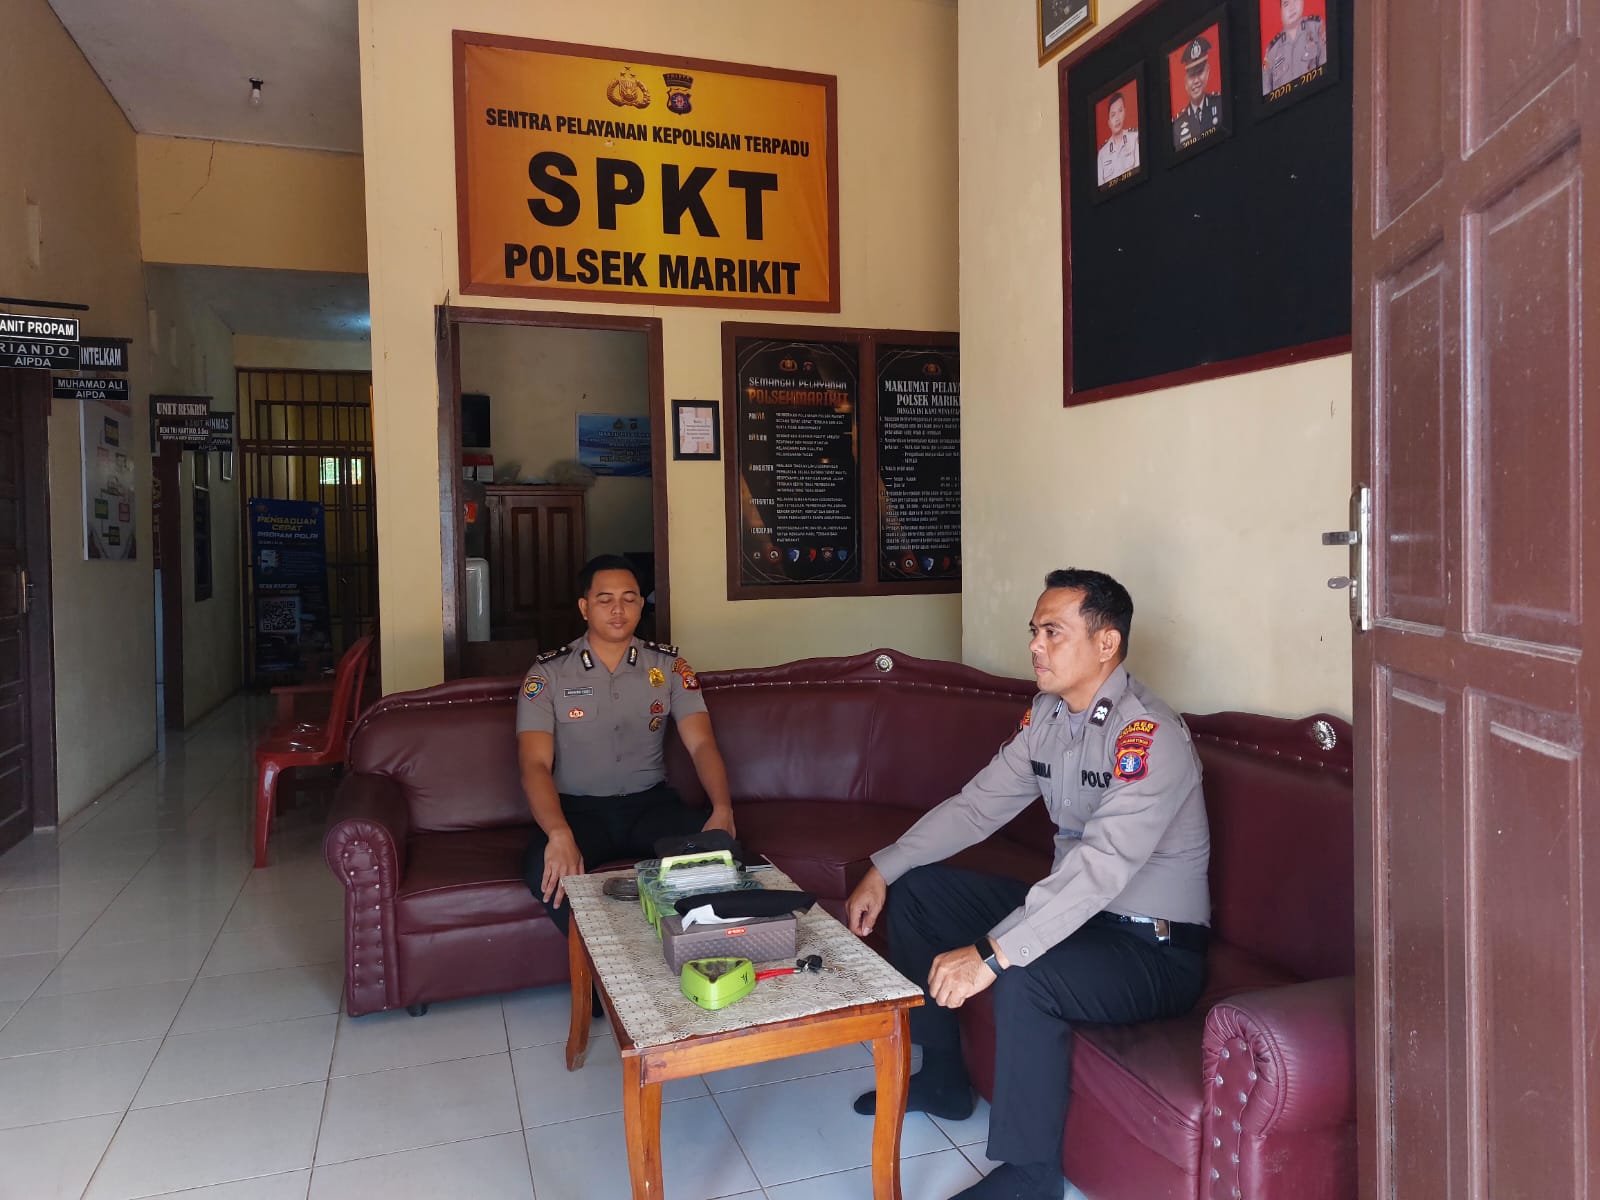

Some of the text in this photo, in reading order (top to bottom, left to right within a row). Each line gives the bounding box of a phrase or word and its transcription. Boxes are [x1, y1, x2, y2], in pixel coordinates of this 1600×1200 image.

[1300, 66, 1324, 85] 2021
[486, 108, 810, 157] SENTRA PELAYANAN KEPOLISIAN TERPADU
[527, 151, 779, 241] SPKT
[504, 243, 801, 295] POLSEK MARIKIT
[0, 319, 74, 336] ANIT PROPAM
[14, 356, 51, 367] AIPDA
[81, 346, 121, 366] INTELKAM
[57, 379, 123, 390] MUHAMAD ALI
[748, 376, 847, 390] SEMANGAT PELAYANAN
[884, 380, 929, 393] MAKLUMAT
[75, 391, 106, 399] AIPDA
[896, 394, 928, 406] POLSEK
[156, 402, 207, 416] UNIT RESKRIM
